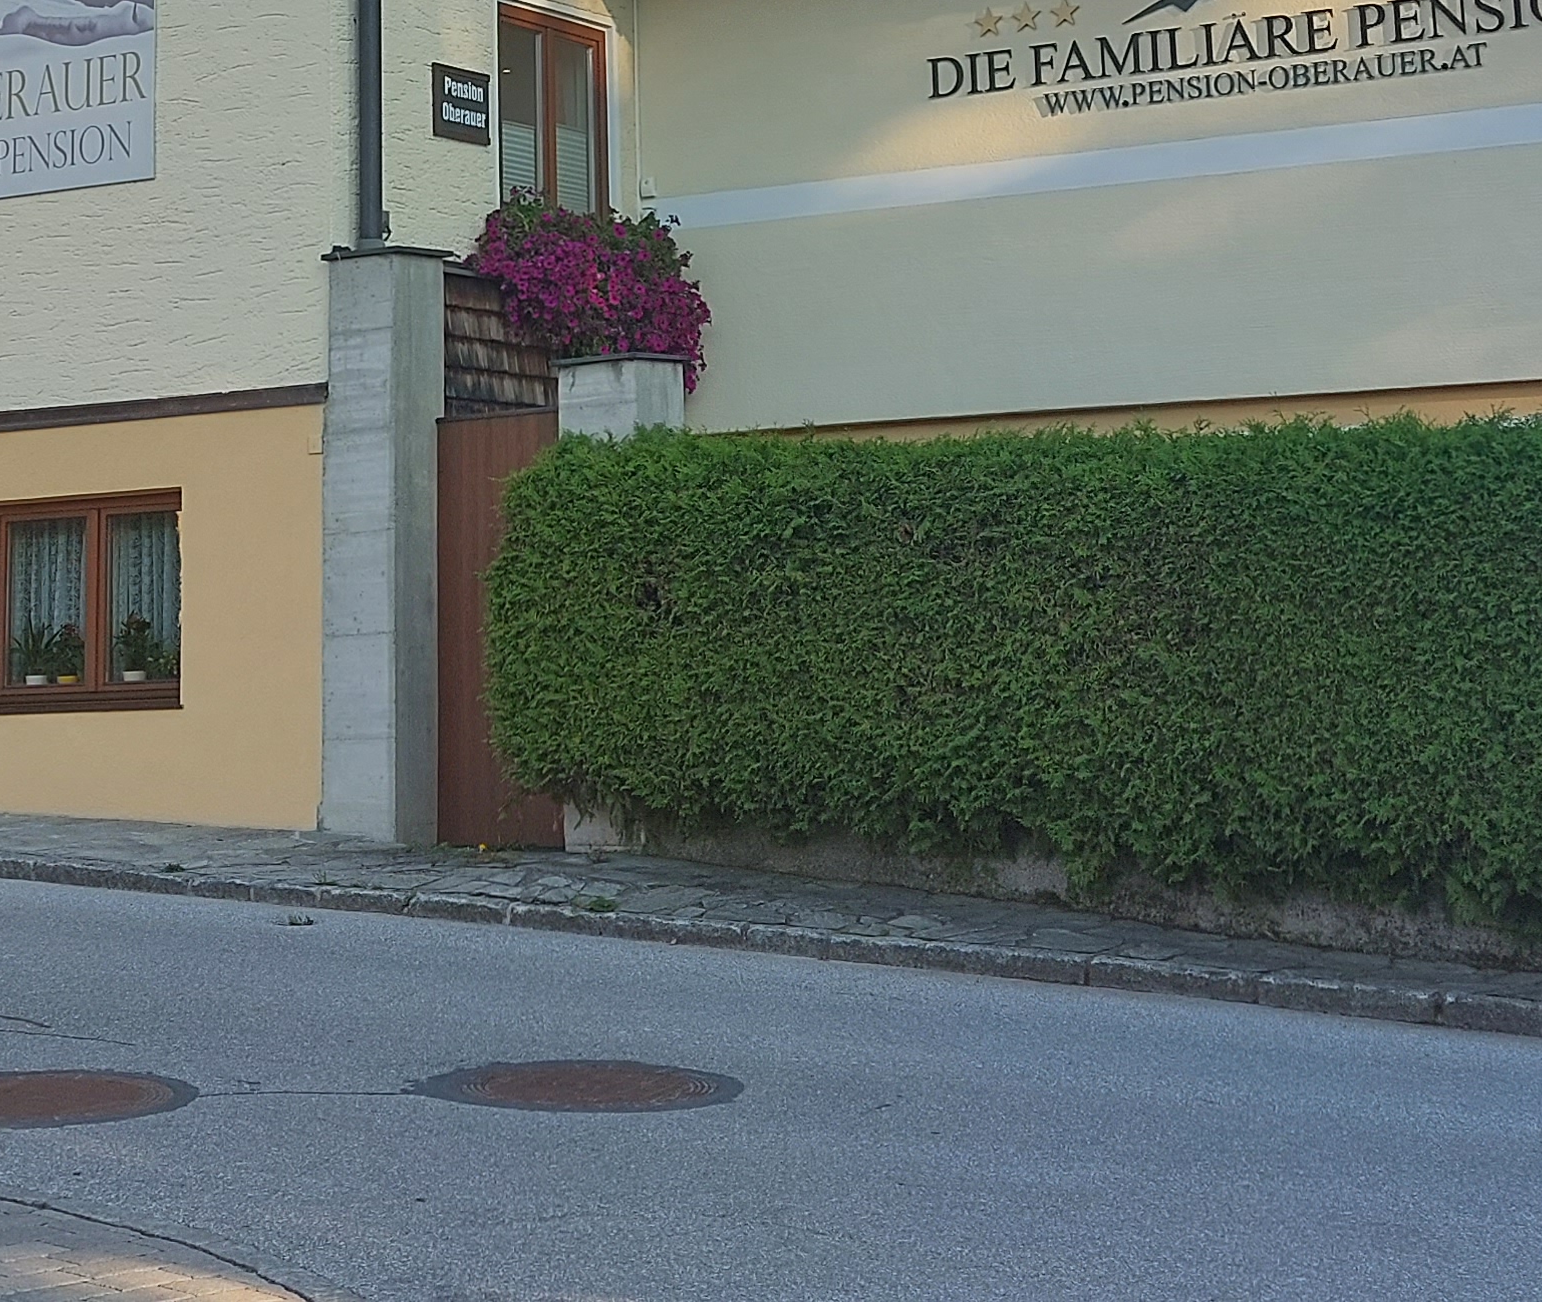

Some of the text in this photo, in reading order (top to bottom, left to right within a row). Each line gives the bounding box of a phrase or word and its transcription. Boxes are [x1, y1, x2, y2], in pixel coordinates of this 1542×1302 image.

[926, 49, 1016, 99] DIE
[1029, 8, 1339, 86] FAMILIÄRE
[1043, 41, 1487, 114] WWW.PENSION-OBERAUER.AT
[443, 75, 484, 103] Pension
[442, 101, 486, 128] Oberauer
